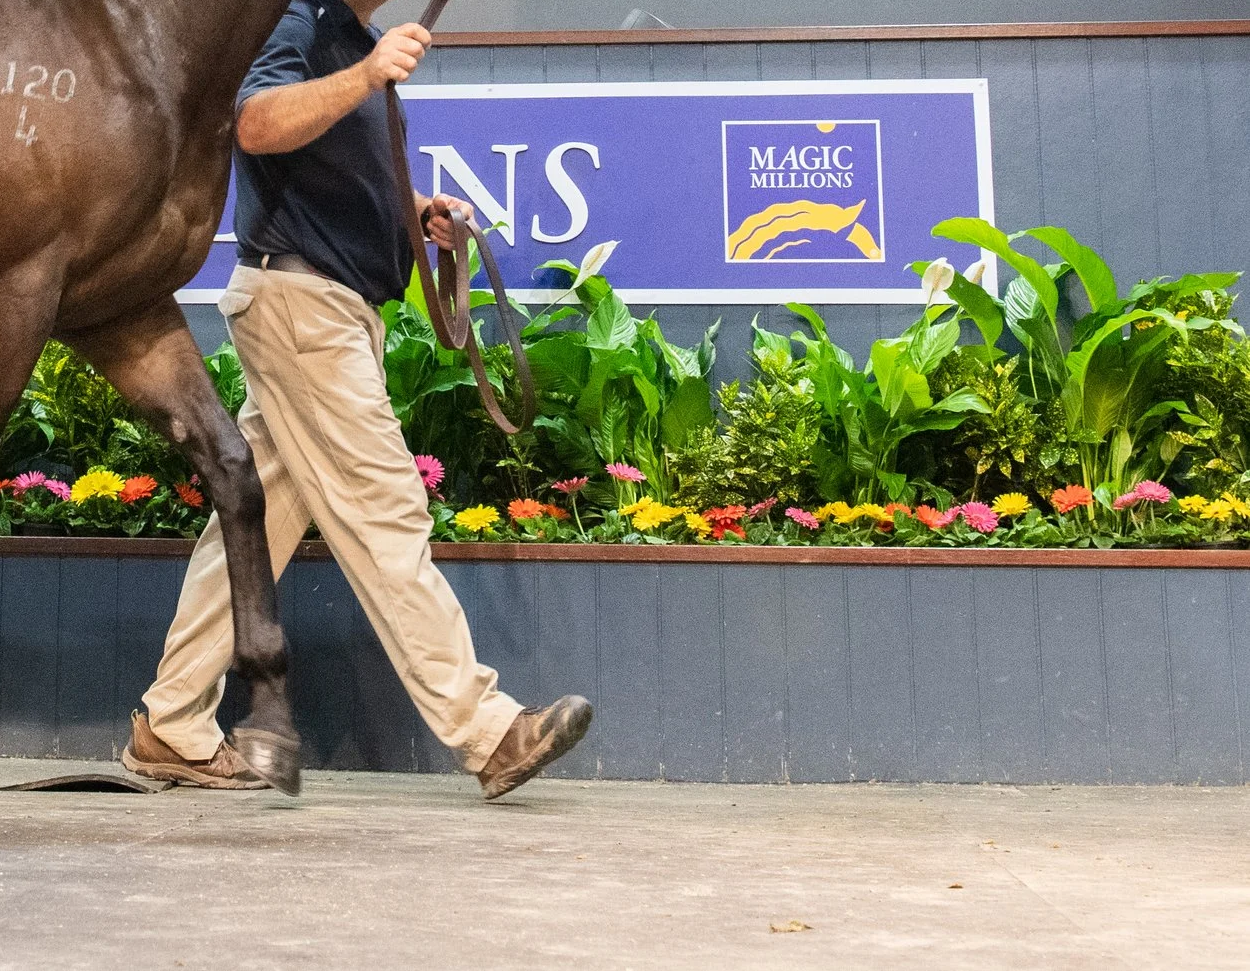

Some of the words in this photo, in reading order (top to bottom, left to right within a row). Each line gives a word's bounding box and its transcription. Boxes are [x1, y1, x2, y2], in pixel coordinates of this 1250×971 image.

[1, 61, 76, 103] 120
[749, 145, 853, 170] MAGIC
[750, 172, 854, 188] MILLIONS
